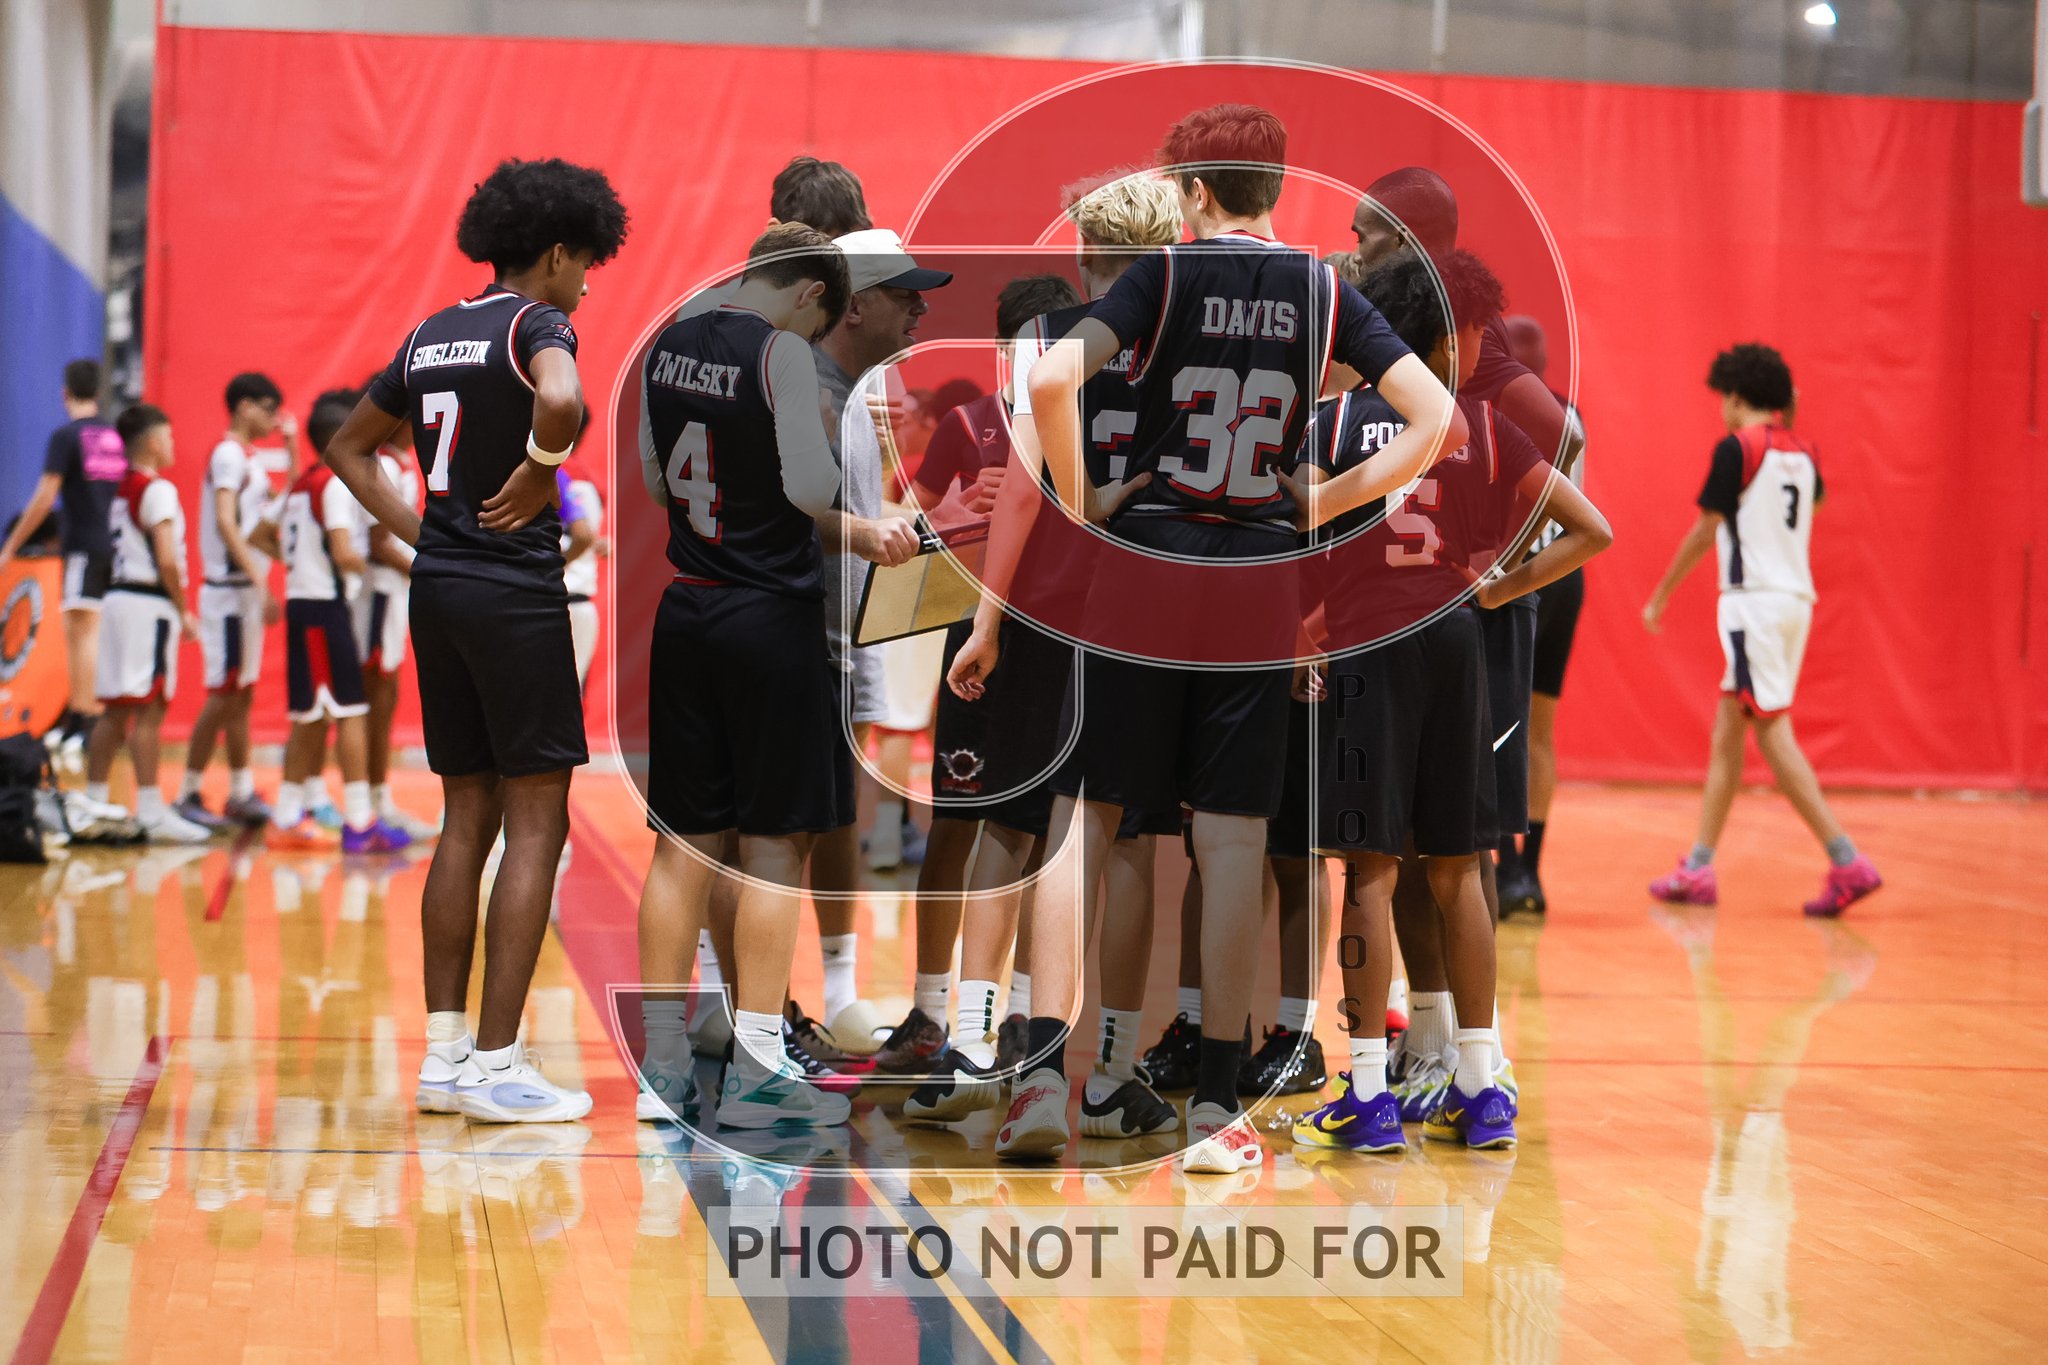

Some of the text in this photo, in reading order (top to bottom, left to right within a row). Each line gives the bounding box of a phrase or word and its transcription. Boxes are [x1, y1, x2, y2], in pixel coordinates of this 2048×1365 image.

[1201, 296, 1298, 342] DAVIS
[651, 350, 742, 400] ZWILSKY
[422, 391, 461, 495] 7
[1157, 366, 1298, 504] 32
[665, 421, 720, 544] 4
[1385, 478, 1443, 568] 5
[1782, 483, 1800, 530] 3
